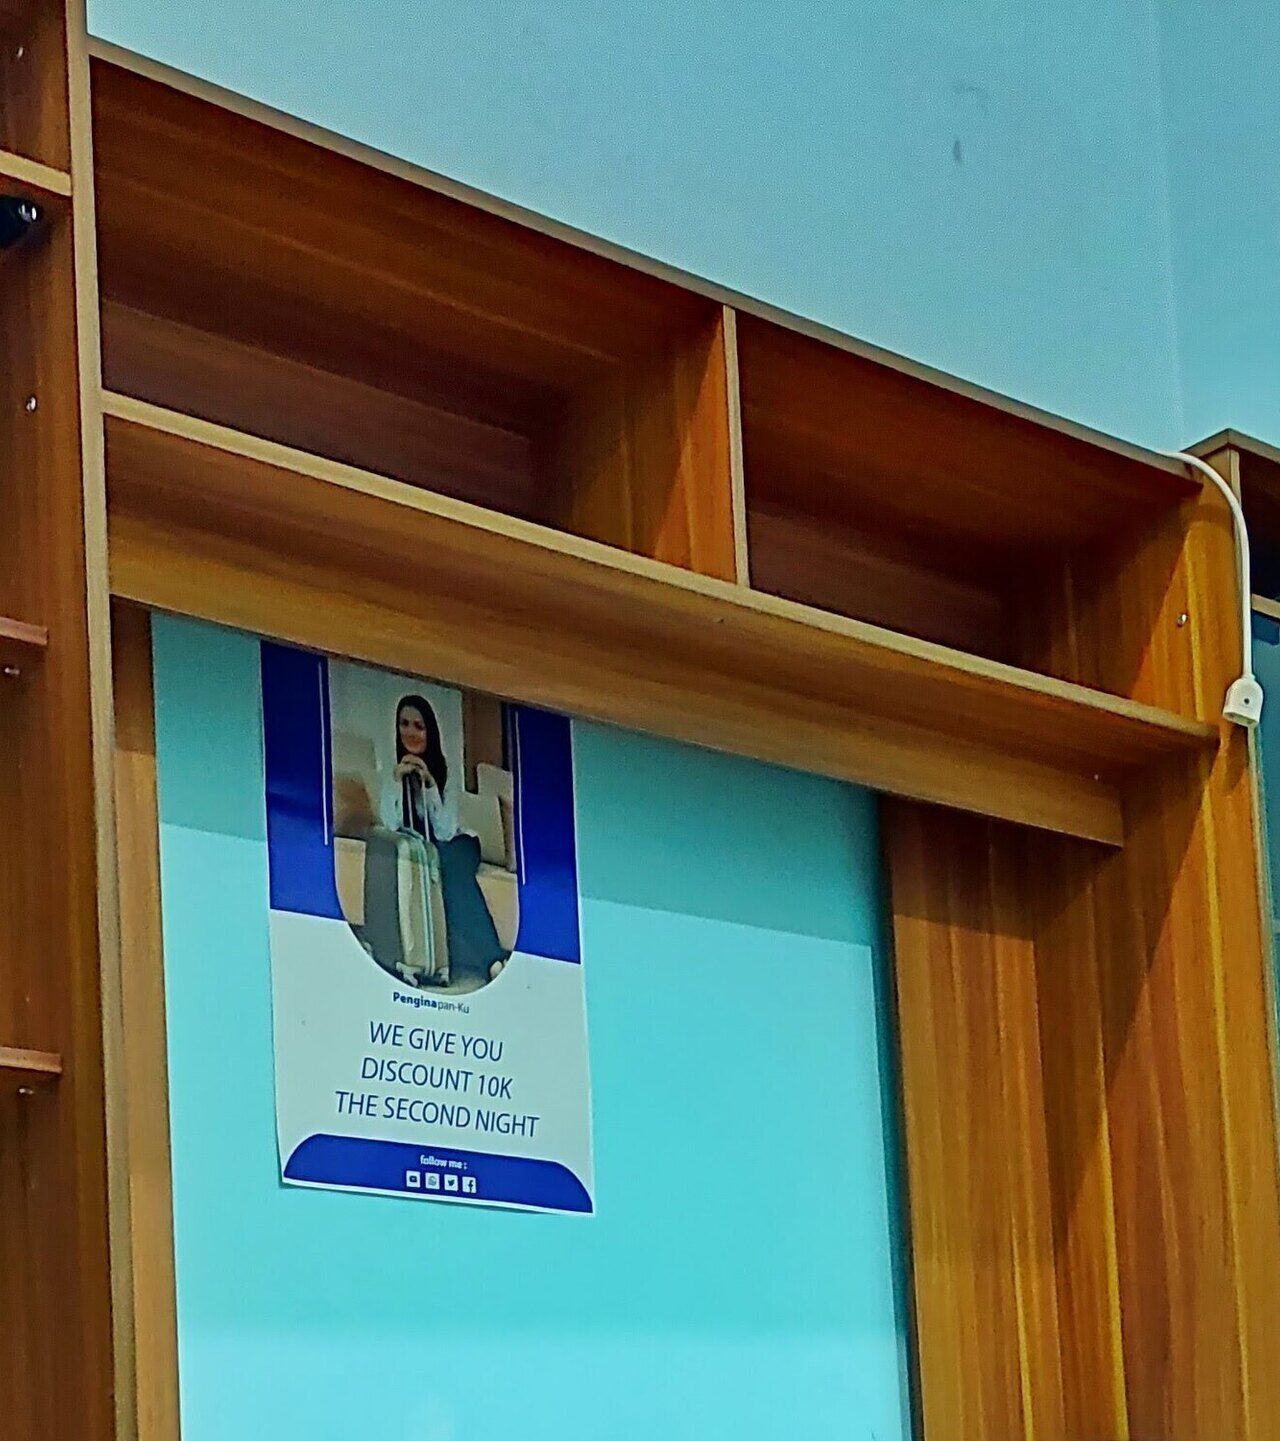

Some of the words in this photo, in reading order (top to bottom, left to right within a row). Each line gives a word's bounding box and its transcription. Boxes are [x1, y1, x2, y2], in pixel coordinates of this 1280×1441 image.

[392, 991, 470, 1014] Penginapan-Ku
[369, 1021, 404, 1047] WE
[408, 1028, 456, 1054] GIVE
[461, 1035, 503, 1062] YOU
[361, 1057, 473, 1093] DISCOUNT
[478, 1075, 513, 1100] 10K
[335, 1091, 379, 1117] THE
[383, 1097, 471, 1128] SECOND
[475, 1110, 540, 1138] NIGHT
[420, 1154, 448, 1168] follow
